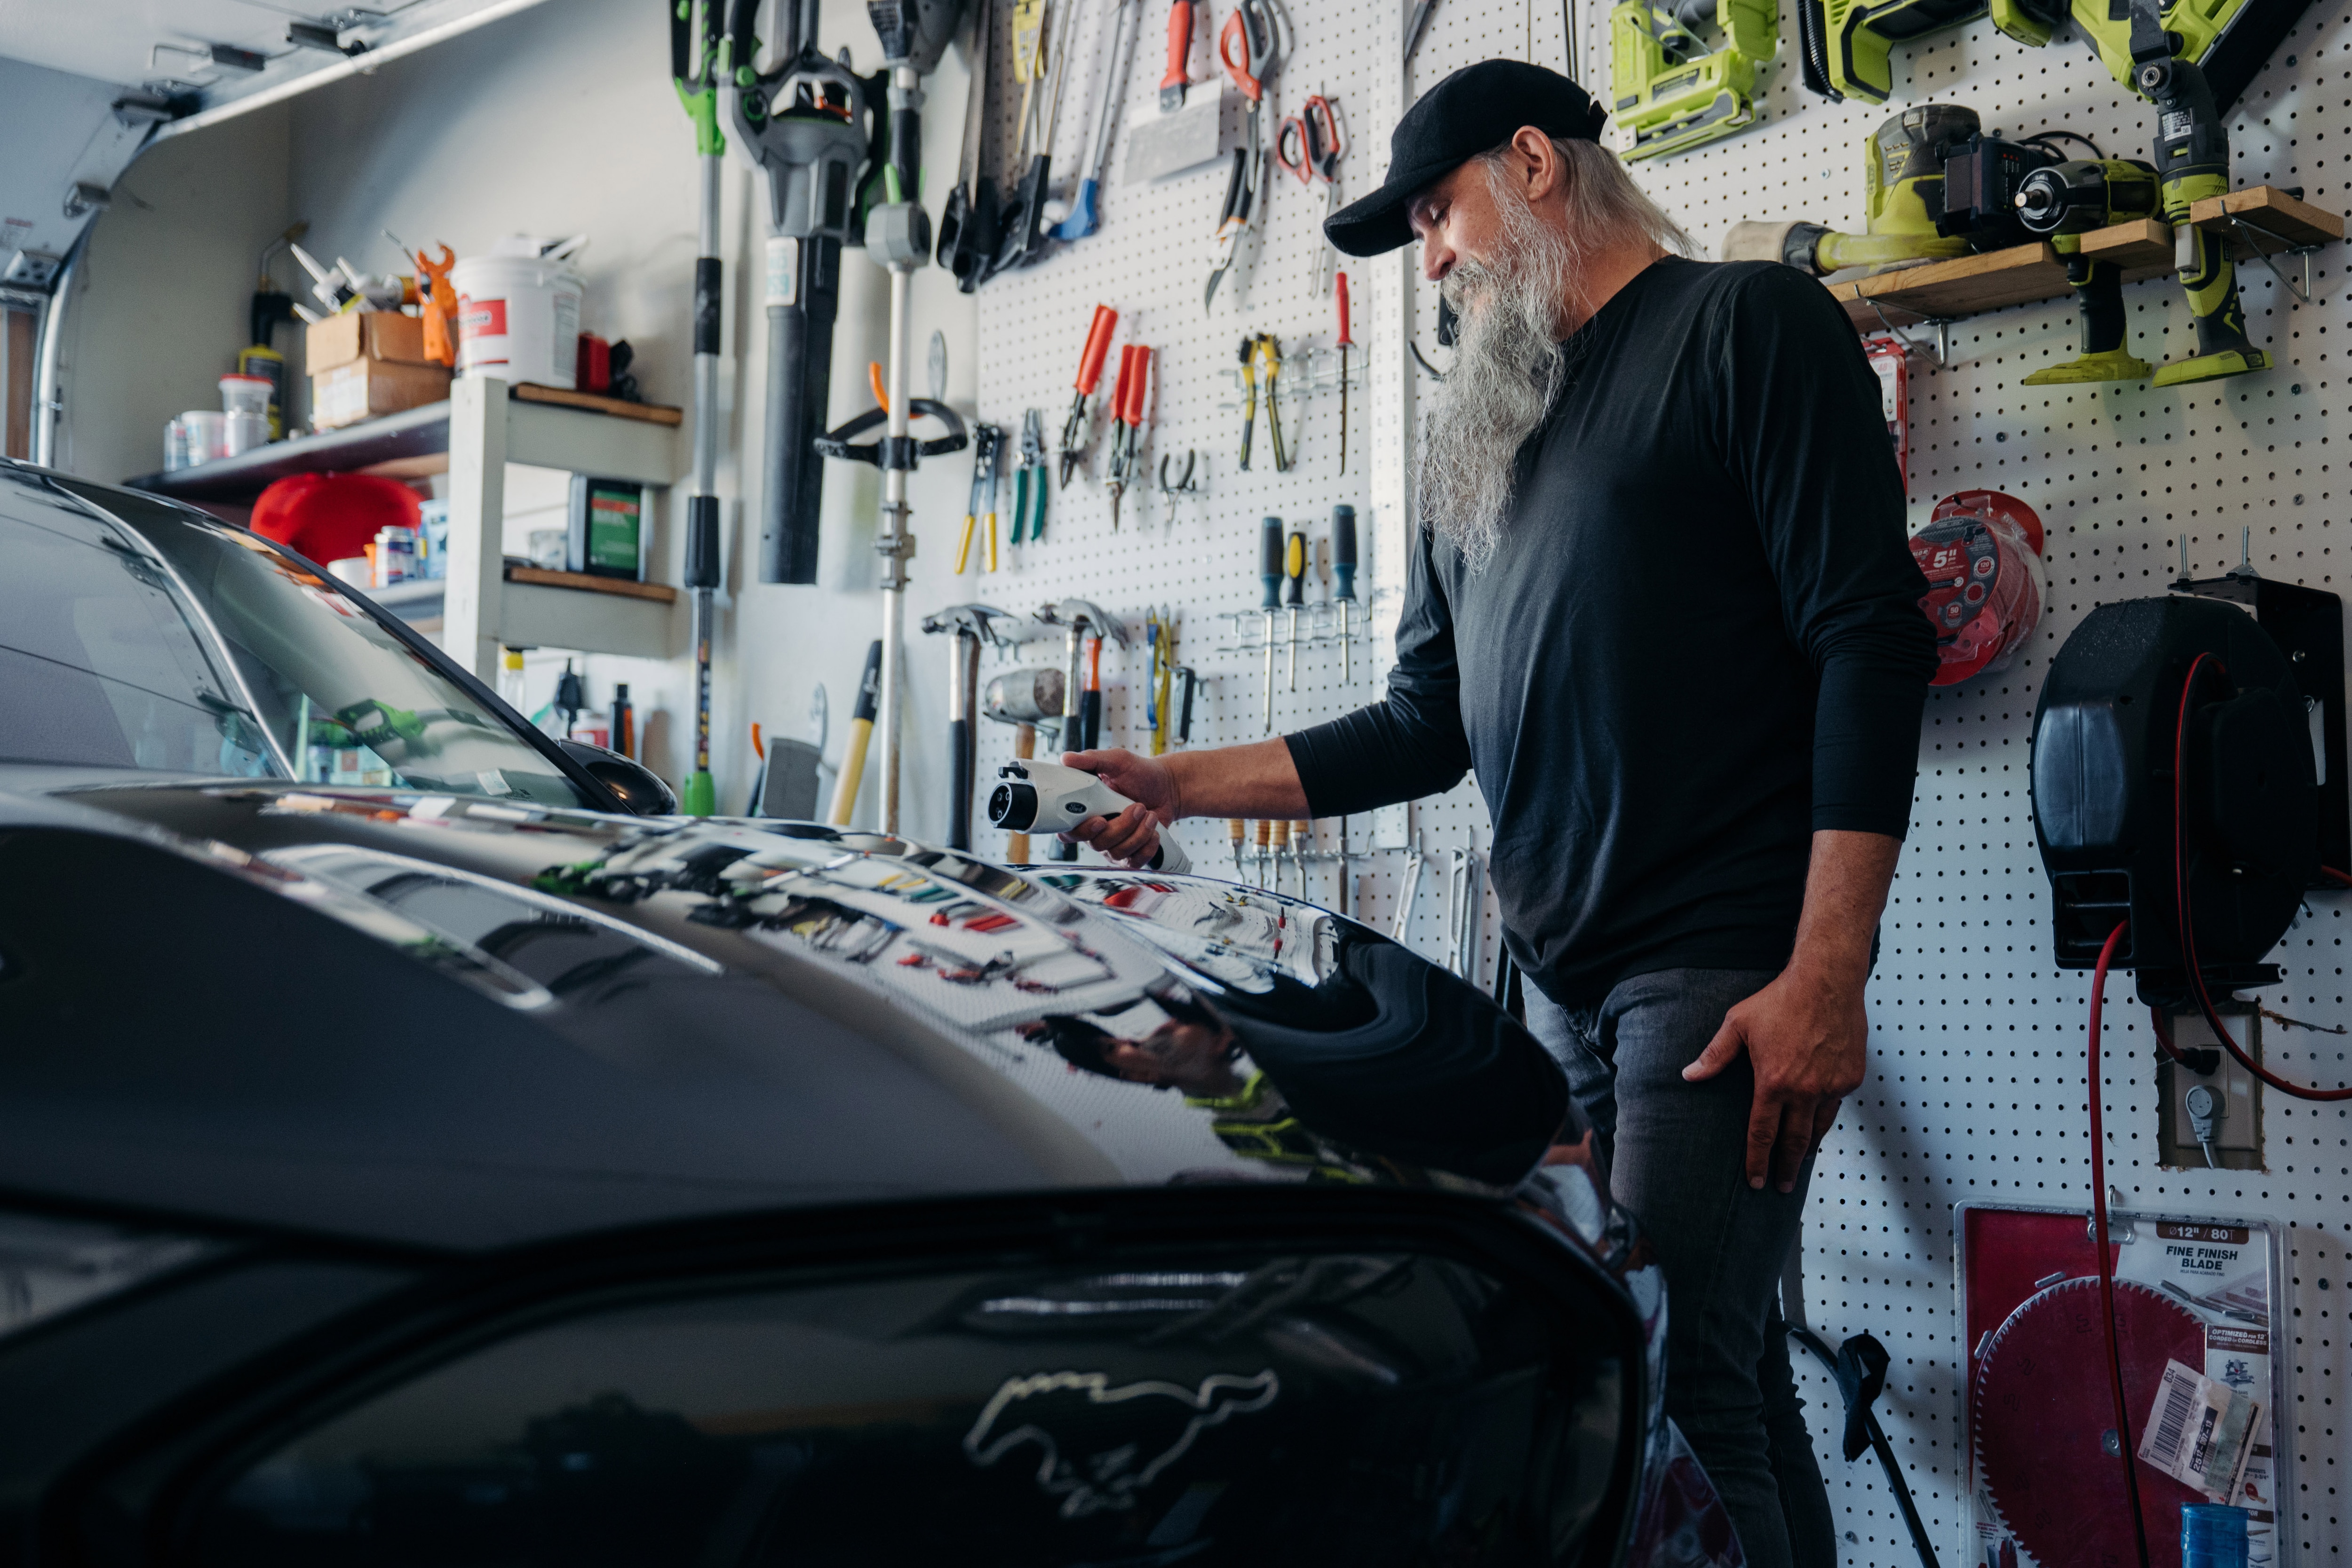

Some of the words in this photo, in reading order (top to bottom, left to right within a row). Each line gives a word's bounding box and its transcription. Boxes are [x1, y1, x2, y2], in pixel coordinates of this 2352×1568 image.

[2166, 1245, 2193, 1257] FINE
[2197, 1248, 2238, 1260] FINISH
[2182, 1258, 2223, 1270] BLADE
[2212, 1329, 2248, 1338] OPTIMIZED
[2164, 1368, 2176, 1384] 034
